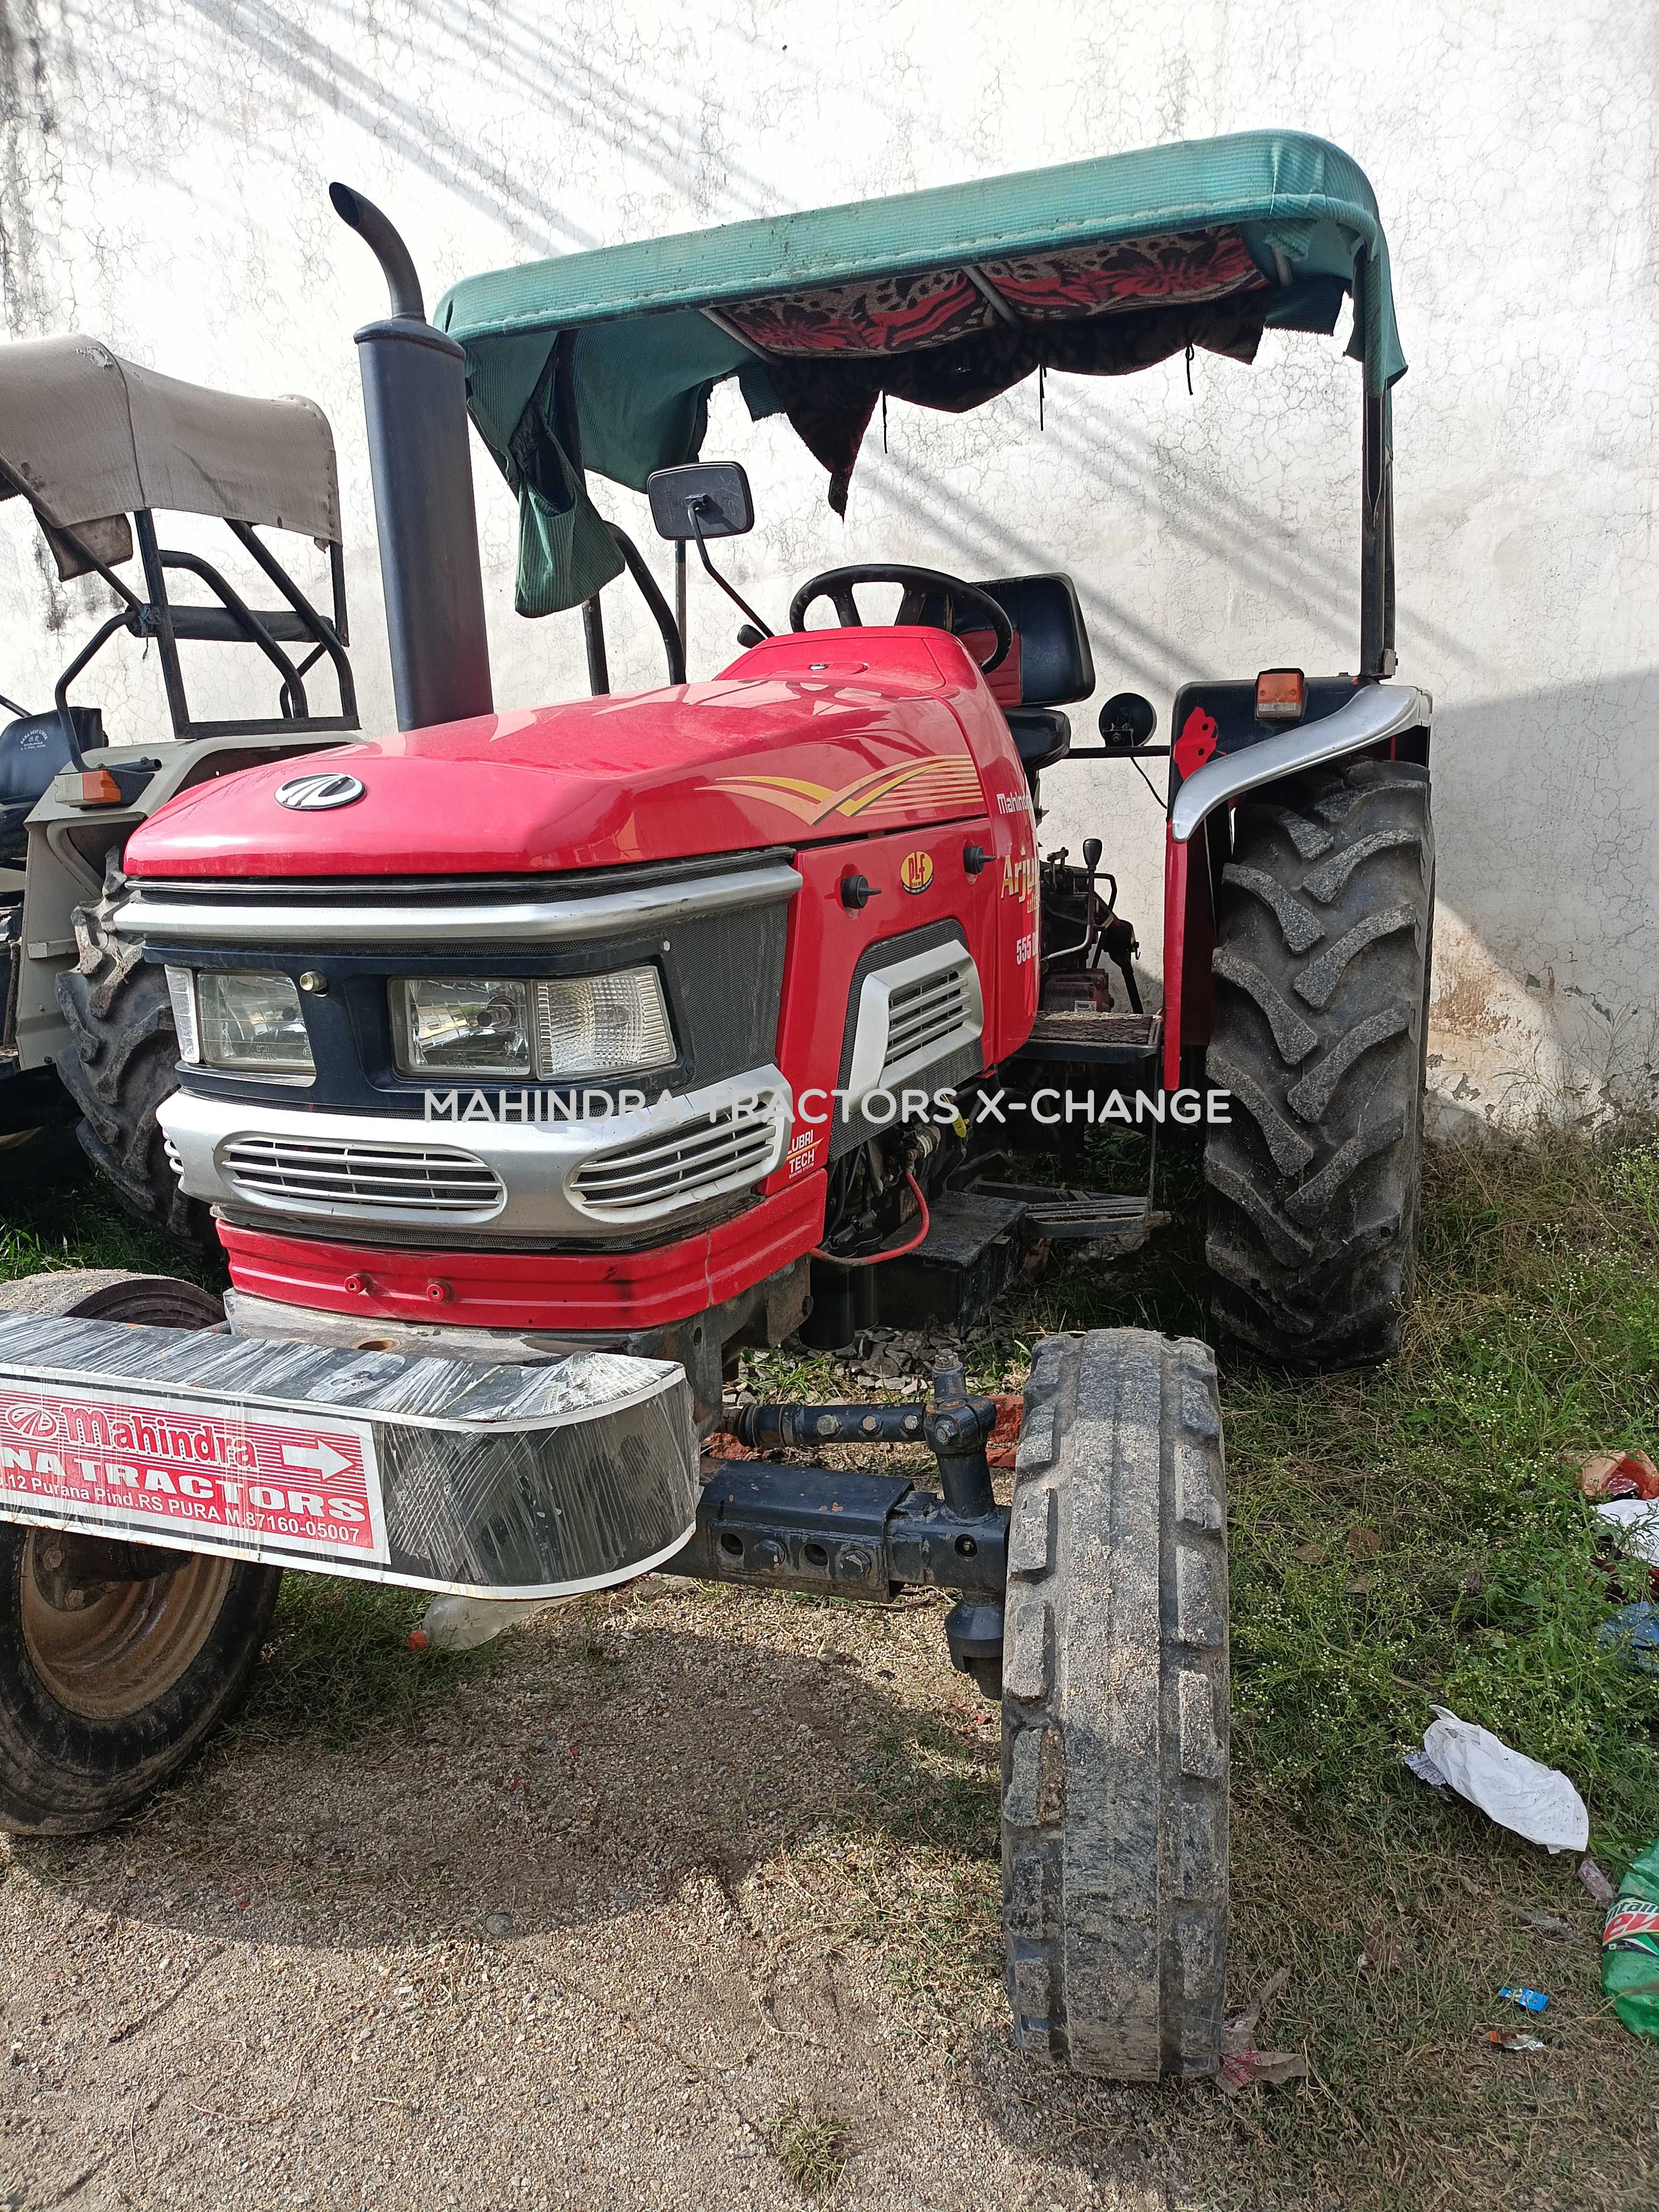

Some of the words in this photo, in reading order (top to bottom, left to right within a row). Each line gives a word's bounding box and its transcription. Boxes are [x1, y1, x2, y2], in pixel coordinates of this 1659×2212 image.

[1017, 934, 1031, 965] 555
[789, 1148, 815, 1173] TECH
[60, 1406, 259, 1470] Mahindra
[31, 1477, 90, 1501] Purana
[95, 1487, 164, 1512] Pind.RS
[169, 1499, 221, 1522] PURA
[225, 1507, 360, 1543] M.87160-05007
[74, 1458, 365, 1522] TRACTORS
